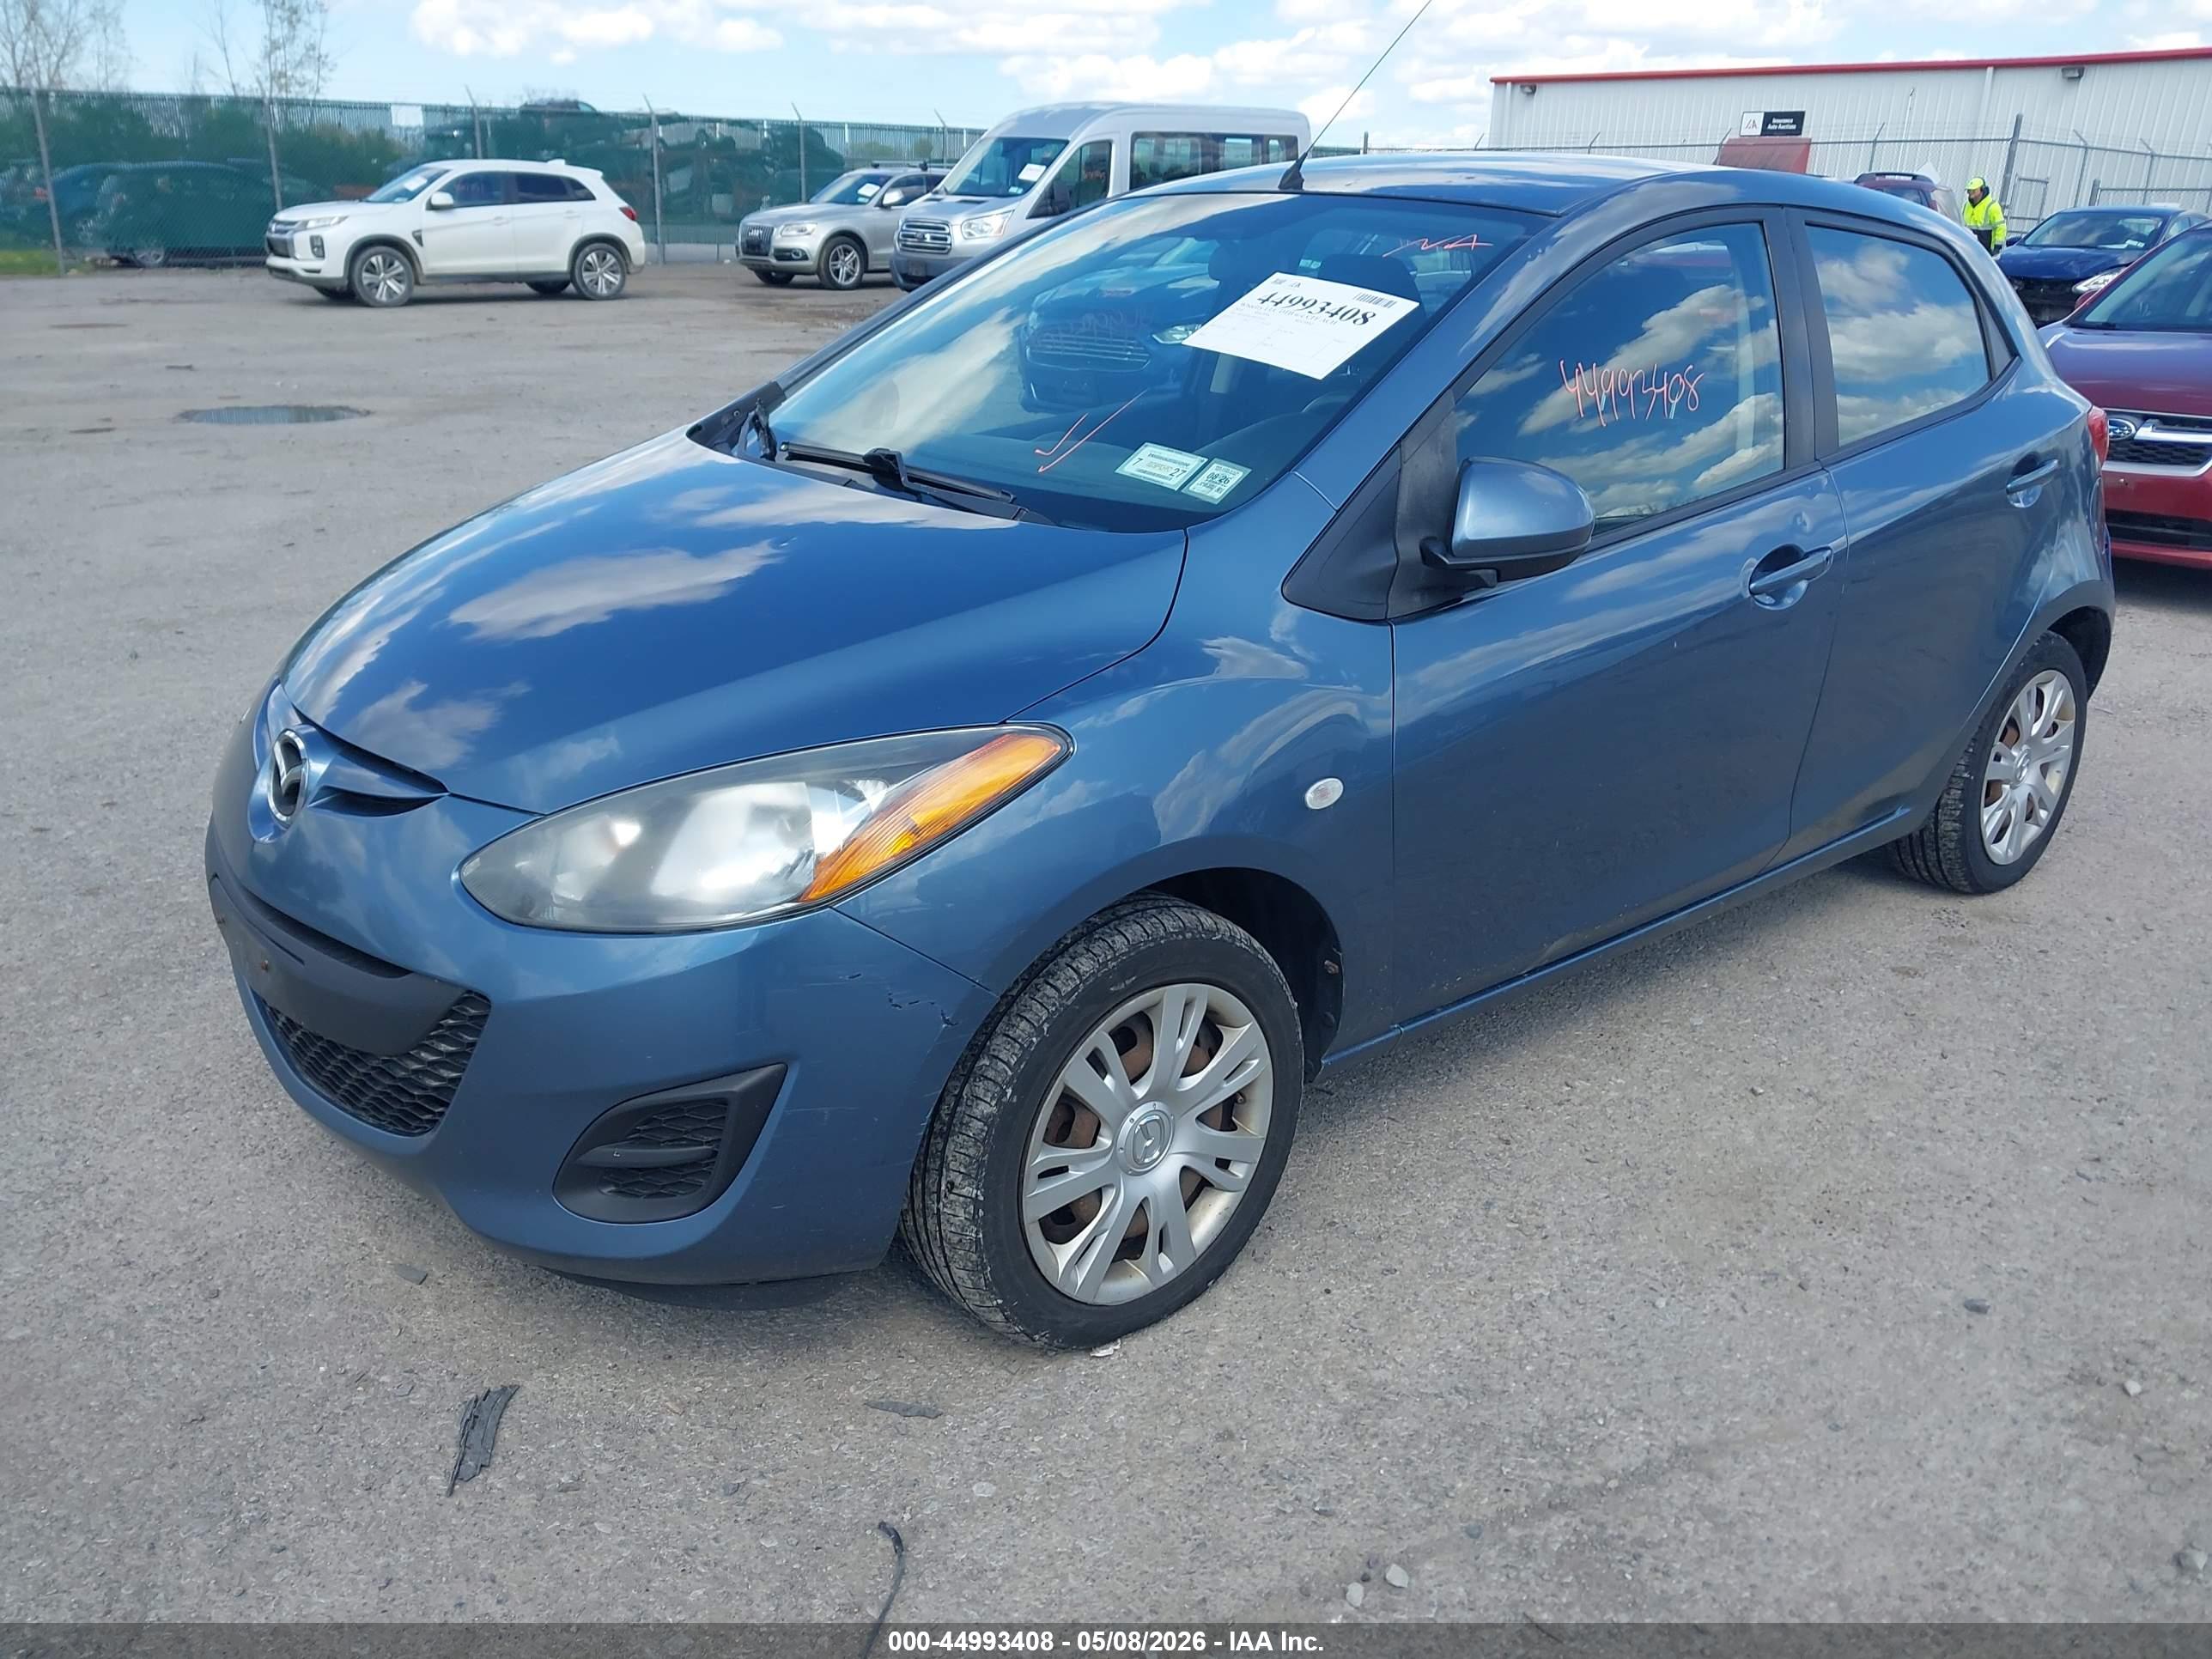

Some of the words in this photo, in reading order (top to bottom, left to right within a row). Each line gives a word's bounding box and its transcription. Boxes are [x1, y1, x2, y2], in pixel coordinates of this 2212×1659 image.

[1257, 292, 1376, 325] 44993408
[1559, 360, 1705, 427] 44993408
[1132, 458, 1143, 466] 7
[1170, 468, 1188, 478] 27
